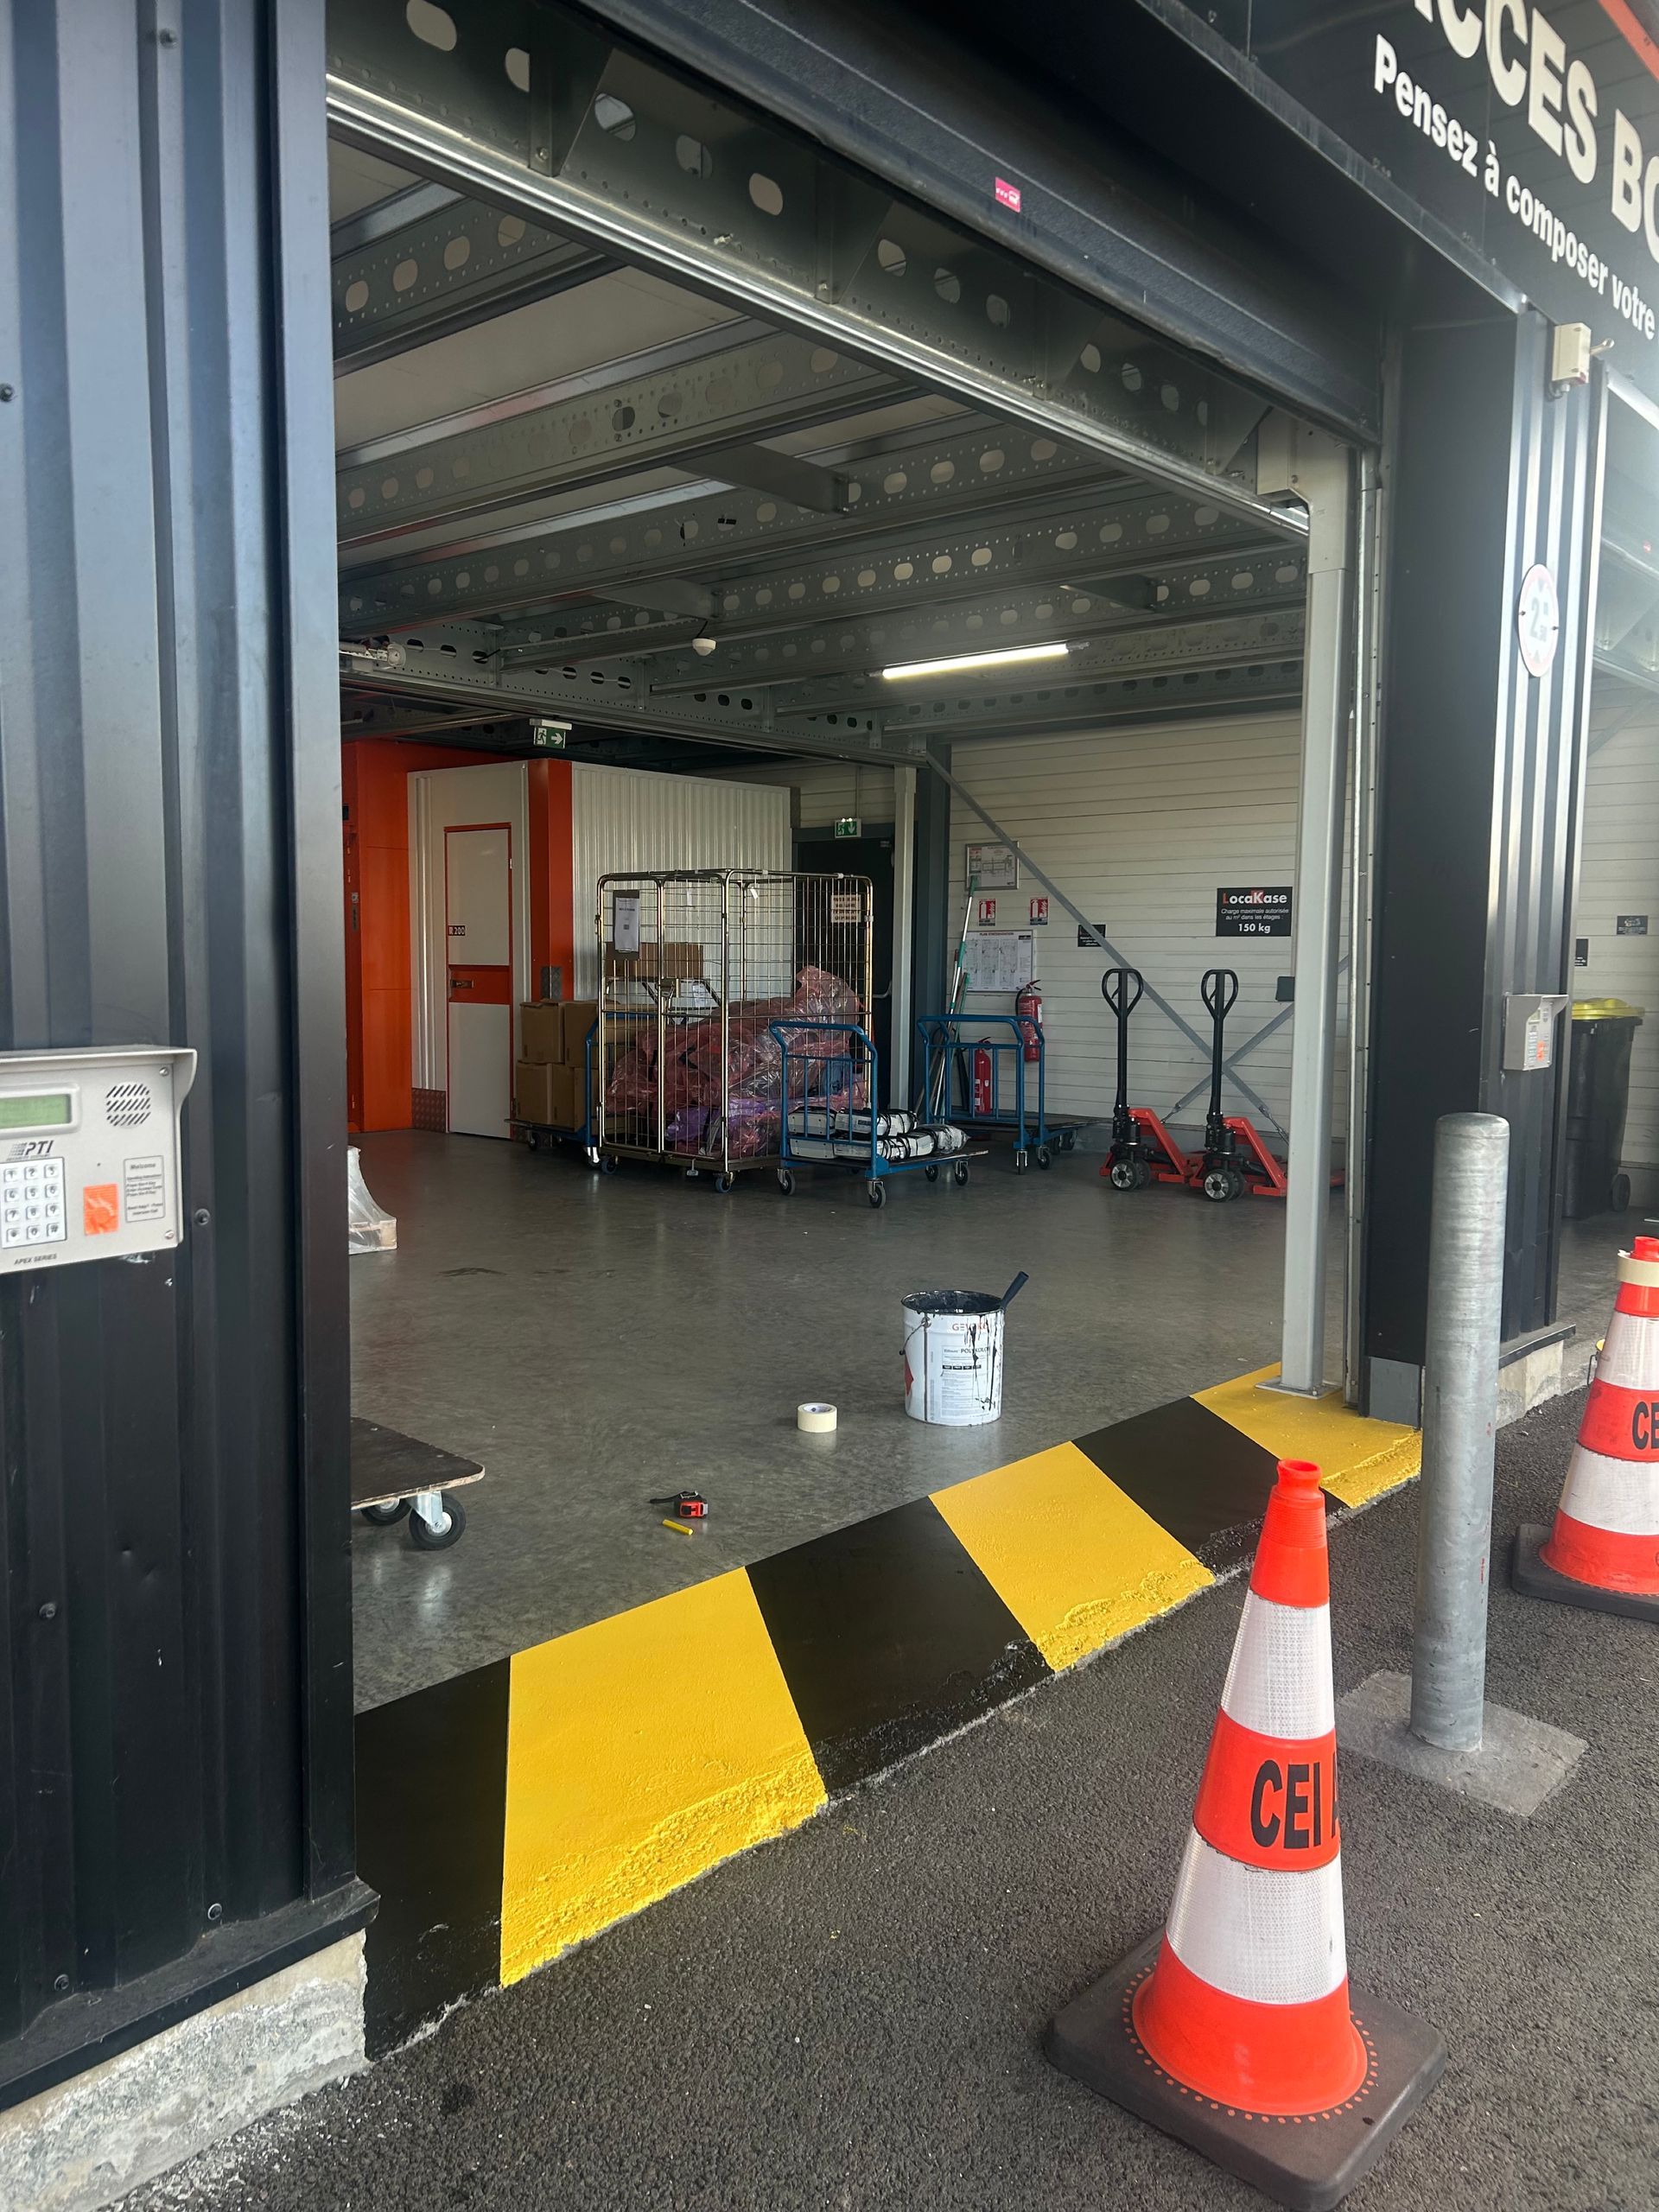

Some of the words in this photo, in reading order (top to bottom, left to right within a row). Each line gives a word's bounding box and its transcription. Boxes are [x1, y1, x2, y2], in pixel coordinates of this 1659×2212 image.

[1414, 0, 1598, 184] CES
[1374, 34, 1478, 177] Pensez
[1484, 139, 1500, 198] à
[1506, 175, 1609, 296] composer
[1612, 274, 1656, 340] votre
[1223, 891, 1287, 905] LocaKase
[1238, 923, 1255, 932] 150
[1258, 923, 1271, 933] kg
[25, 1140, 54, 1155] PTI
[14, 1256, 32, 1265] APEX
[34, 1253, 58, 1263] SERIES
[951, 1323, 988, 1332] GEVKO
